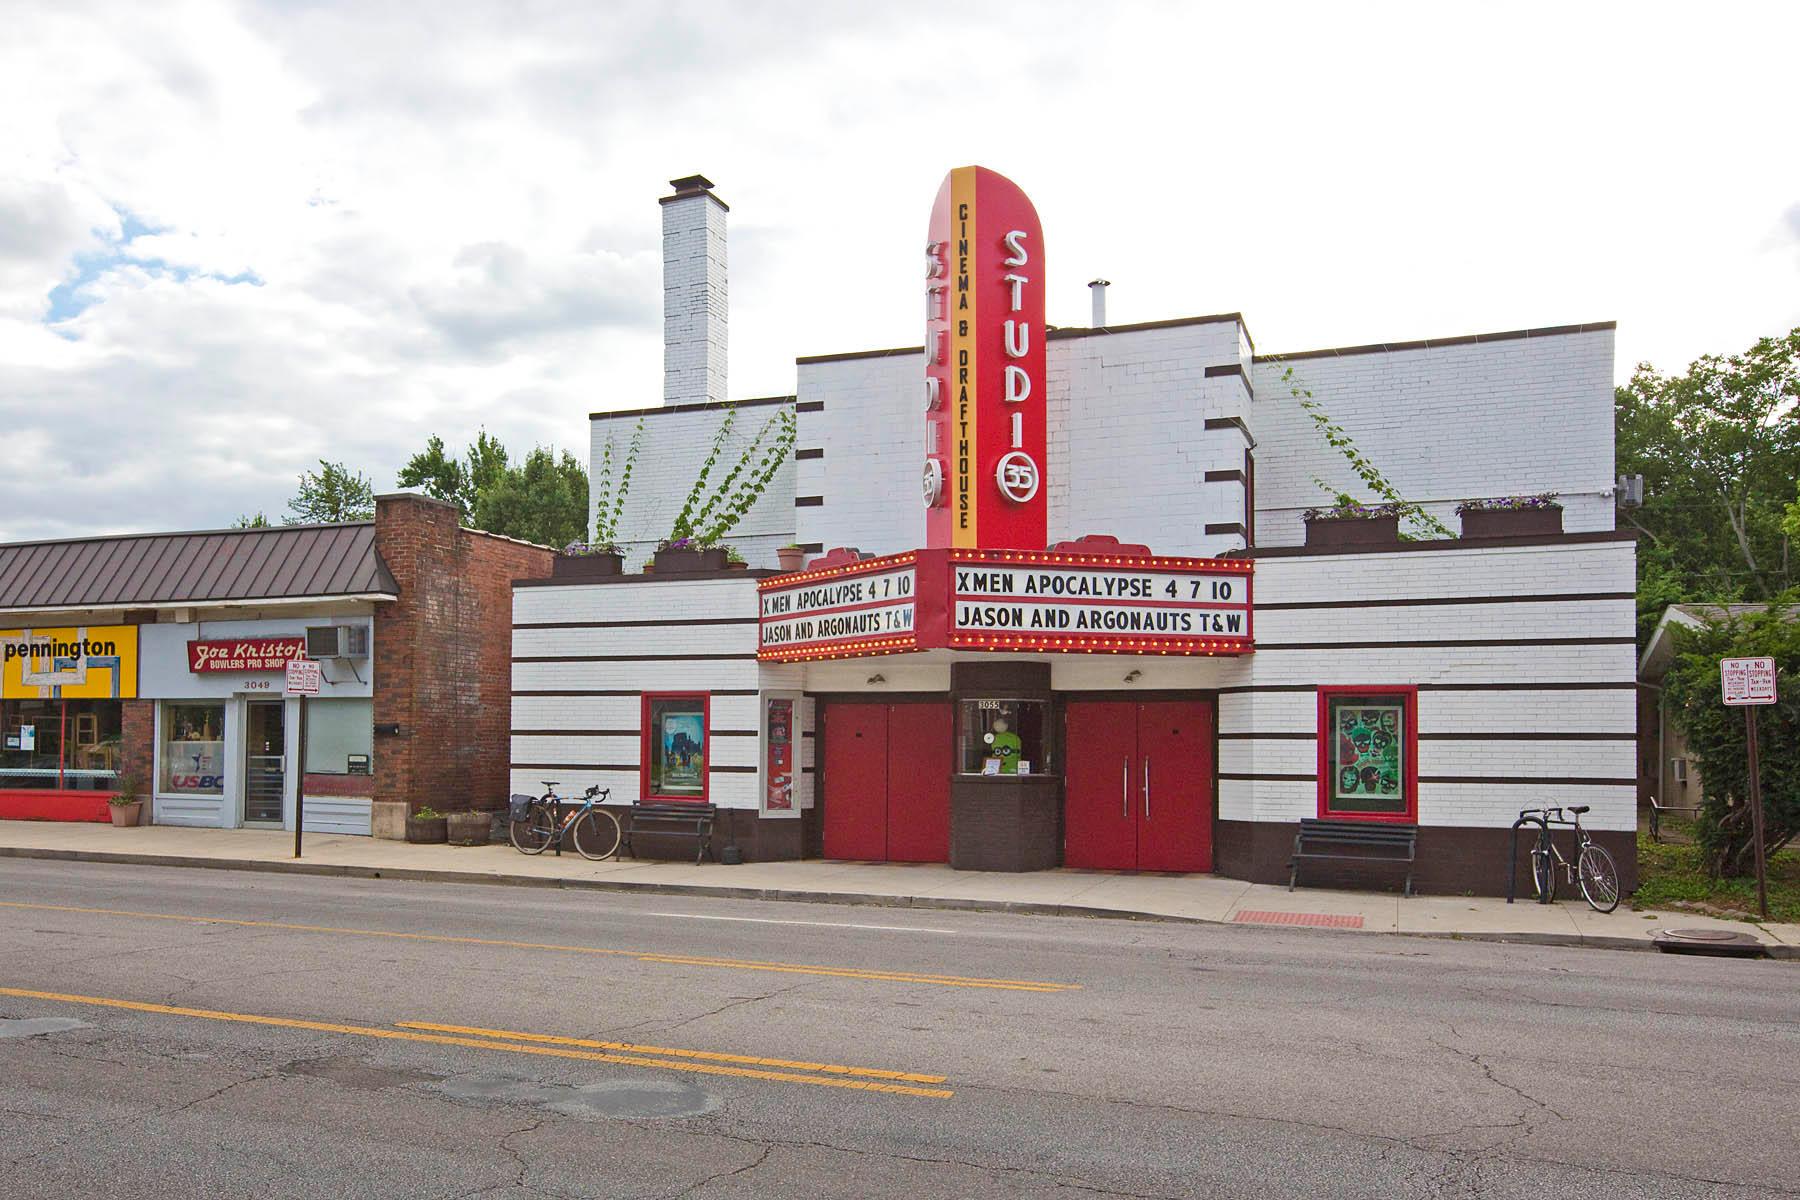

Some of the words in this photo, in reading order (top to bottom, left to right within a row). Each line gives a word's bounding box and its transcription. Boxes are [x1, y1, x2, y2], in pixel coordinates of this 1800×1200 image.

[958, 203, 969, 310] CINEMA
[959, 319, 969, 337] &
[958, 348, 969, 529] DRAFTHOUSE
[1003, 464, 1033, 490] 35
[797, 583, 863, 610] APOCALYPSE
[868, 581, 876, 599] 4
[883, 579, 890, 597] 7
[897, 575, 911, 596] 10
[1025, 574, 1152, 598] APOCALYPSE
[1165, 579, 1178, 598] 4
[1190, 580, 1200, 599] 7
[1212, 581, 1232, 600] 10
[763, 624, 792, 643] JASON
[795, 621, 813, 640] AND
[818, 613, 880, 637] ARGONAUTS
[958, 606, 1023, 627] JASON
[1031, 608, 1070, 629] AND
[1076, 609, 1192, 632] ARGONAUTS
[5, 638, 116, 662] pennington
[194, 645, 229, 669] Joe
[210, 658, 245, 669] BOWLERS
[247, 658, 262, 669] PRO
[265, 658, 285, 668] SHOP
[1754, 661, 1765, 669] NO
[172, 775, 224, 788] USBC
